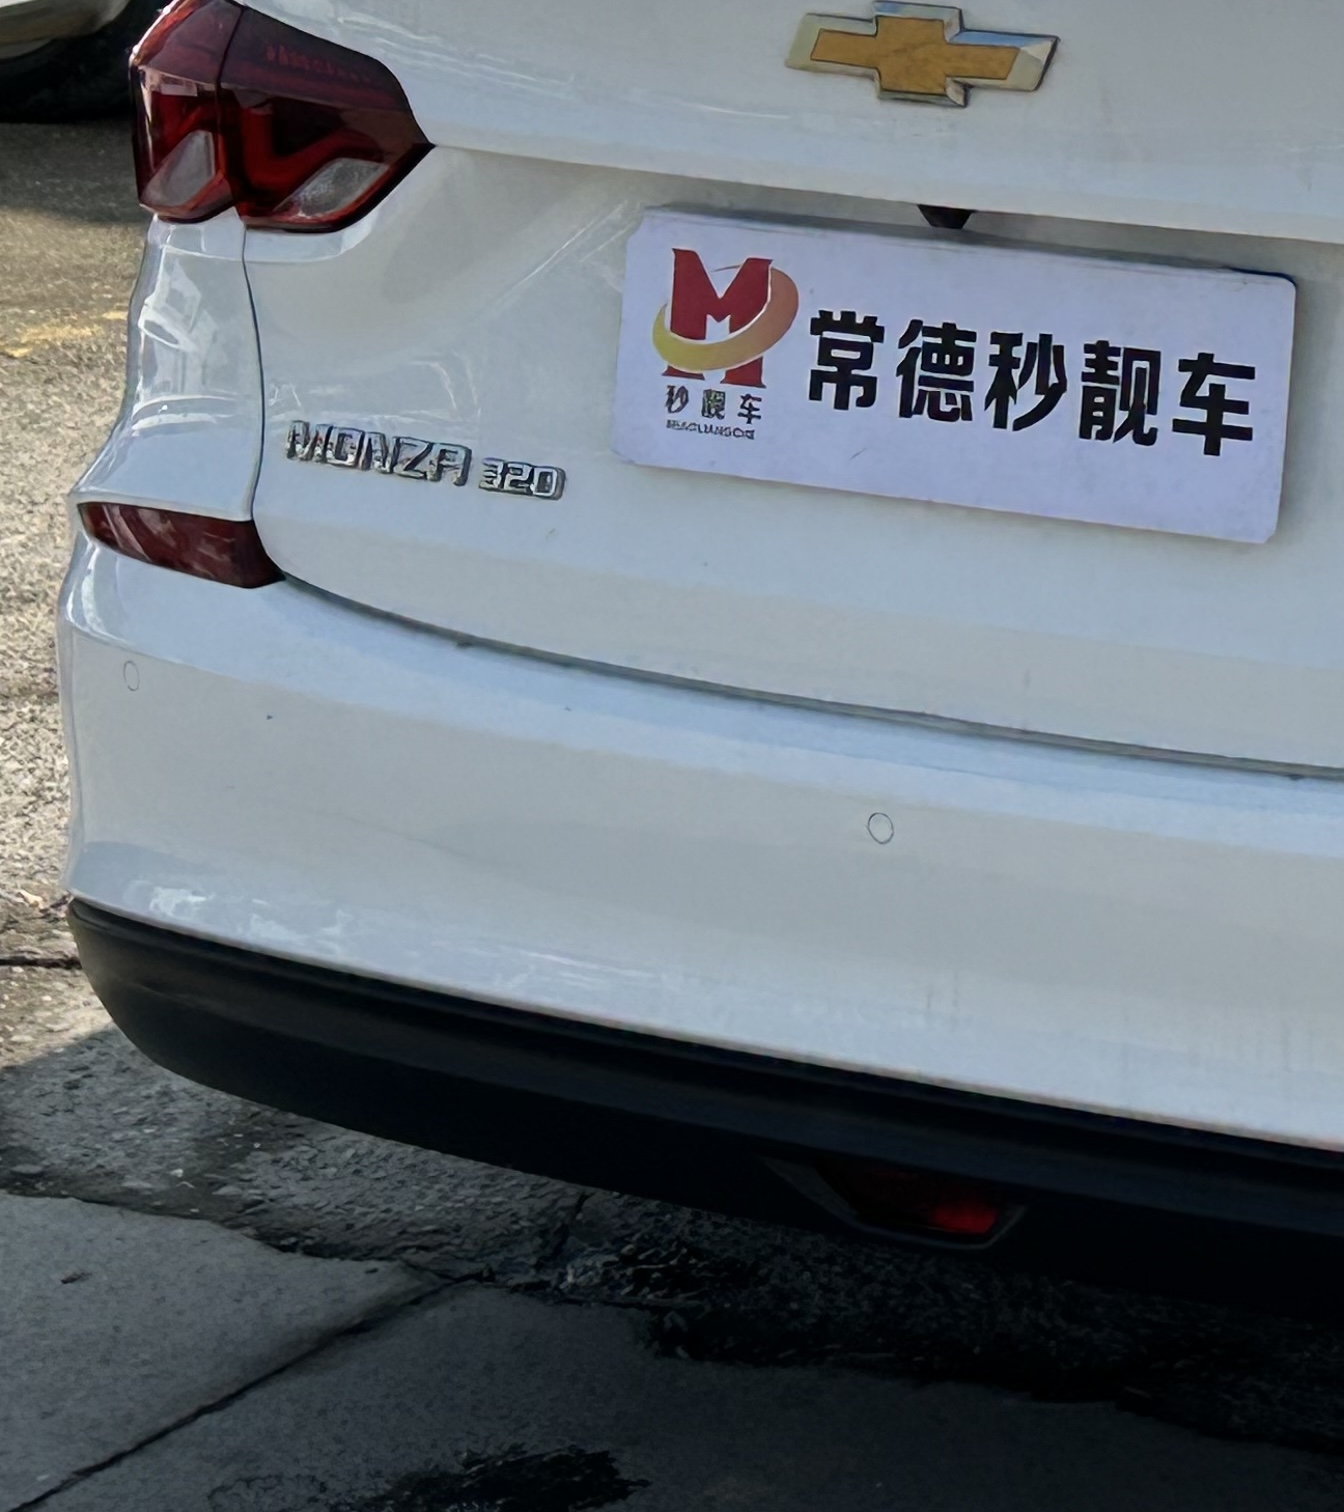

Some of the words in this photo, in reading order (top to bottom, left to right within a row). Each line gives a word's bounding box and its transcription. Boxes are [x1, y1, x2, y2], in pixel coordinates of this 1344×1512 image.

[664, 384, 763, 425] 秒靓车
[807, 309, 1256, 458] 常德秒靓车
[285, 419, 473, 488] MONZA
[478, 457, 567, 500] 320
